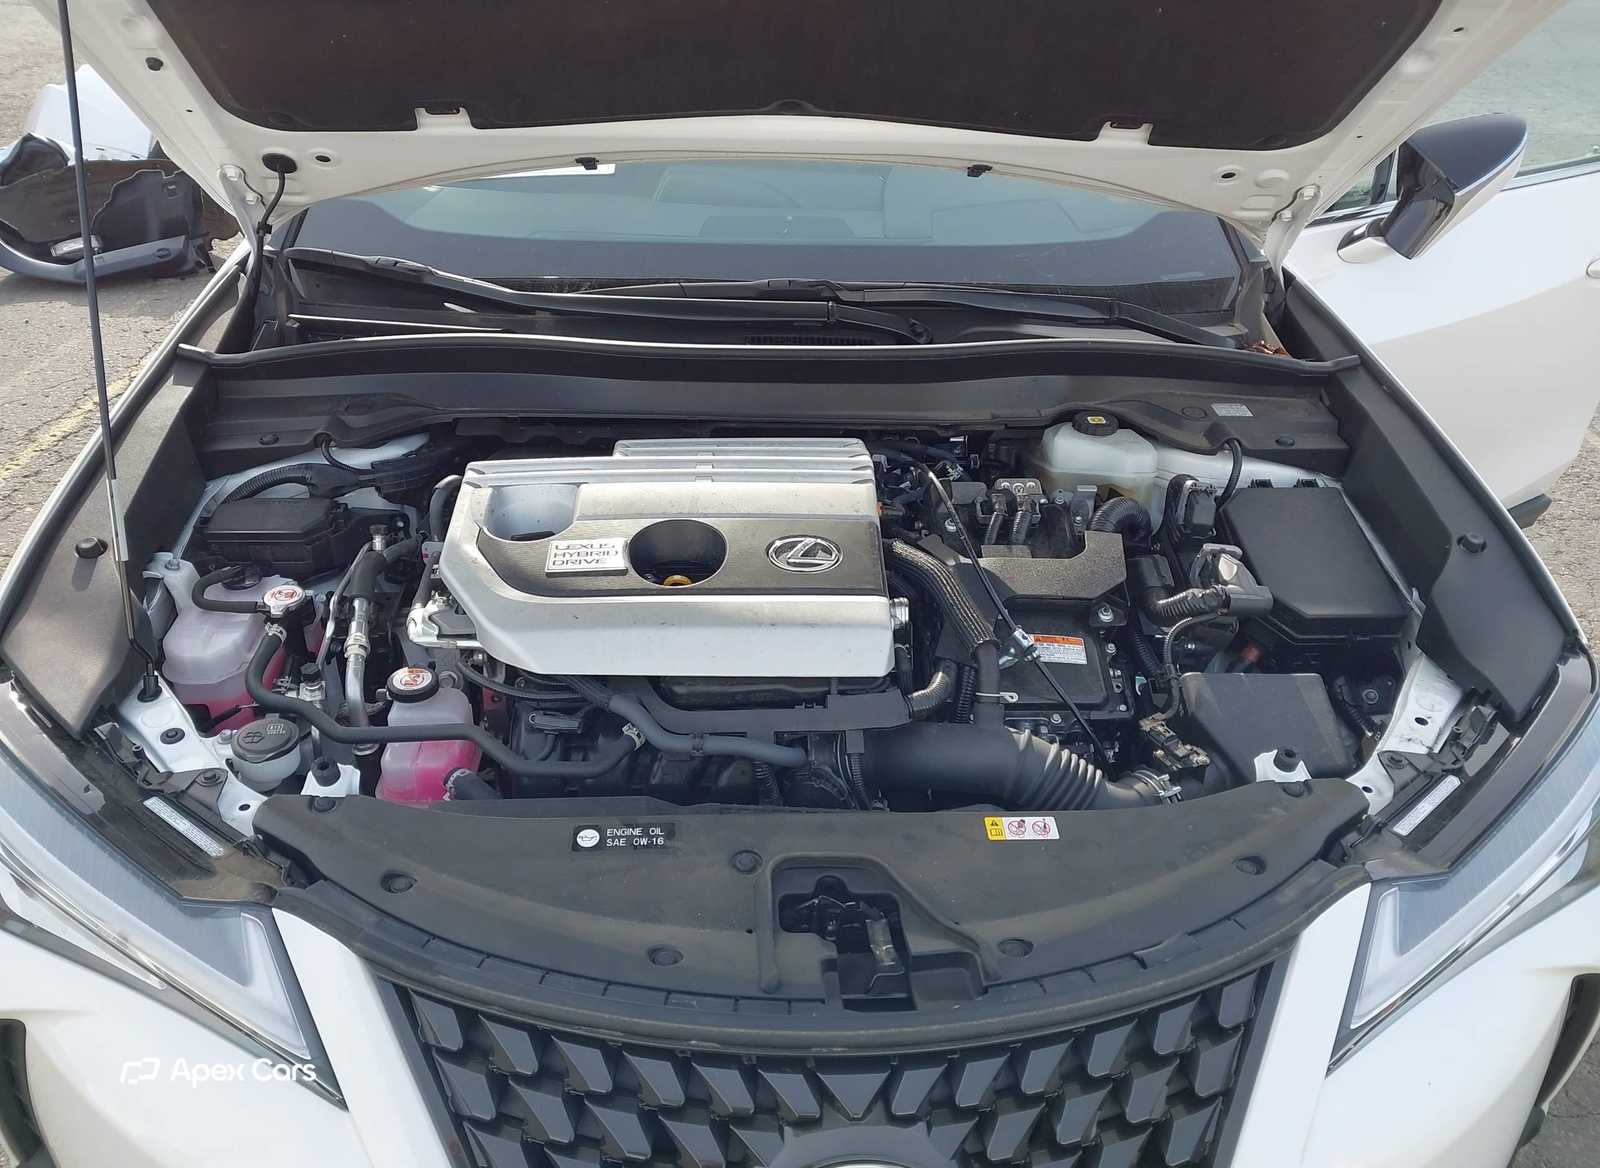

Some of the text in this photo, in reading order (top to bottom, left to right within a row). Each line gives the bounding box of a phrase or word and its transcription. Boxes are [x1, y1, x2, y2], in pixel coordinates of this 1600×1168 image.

[555, 543, 616, 551] LEXUS
[553, 550, 619, 558] HYBRID
[552, 557, 607, 566] DRIVE
[606, 827, 665, 837] ENGINE OIL
[606, 837, 665, 847] SAE 0W-16
